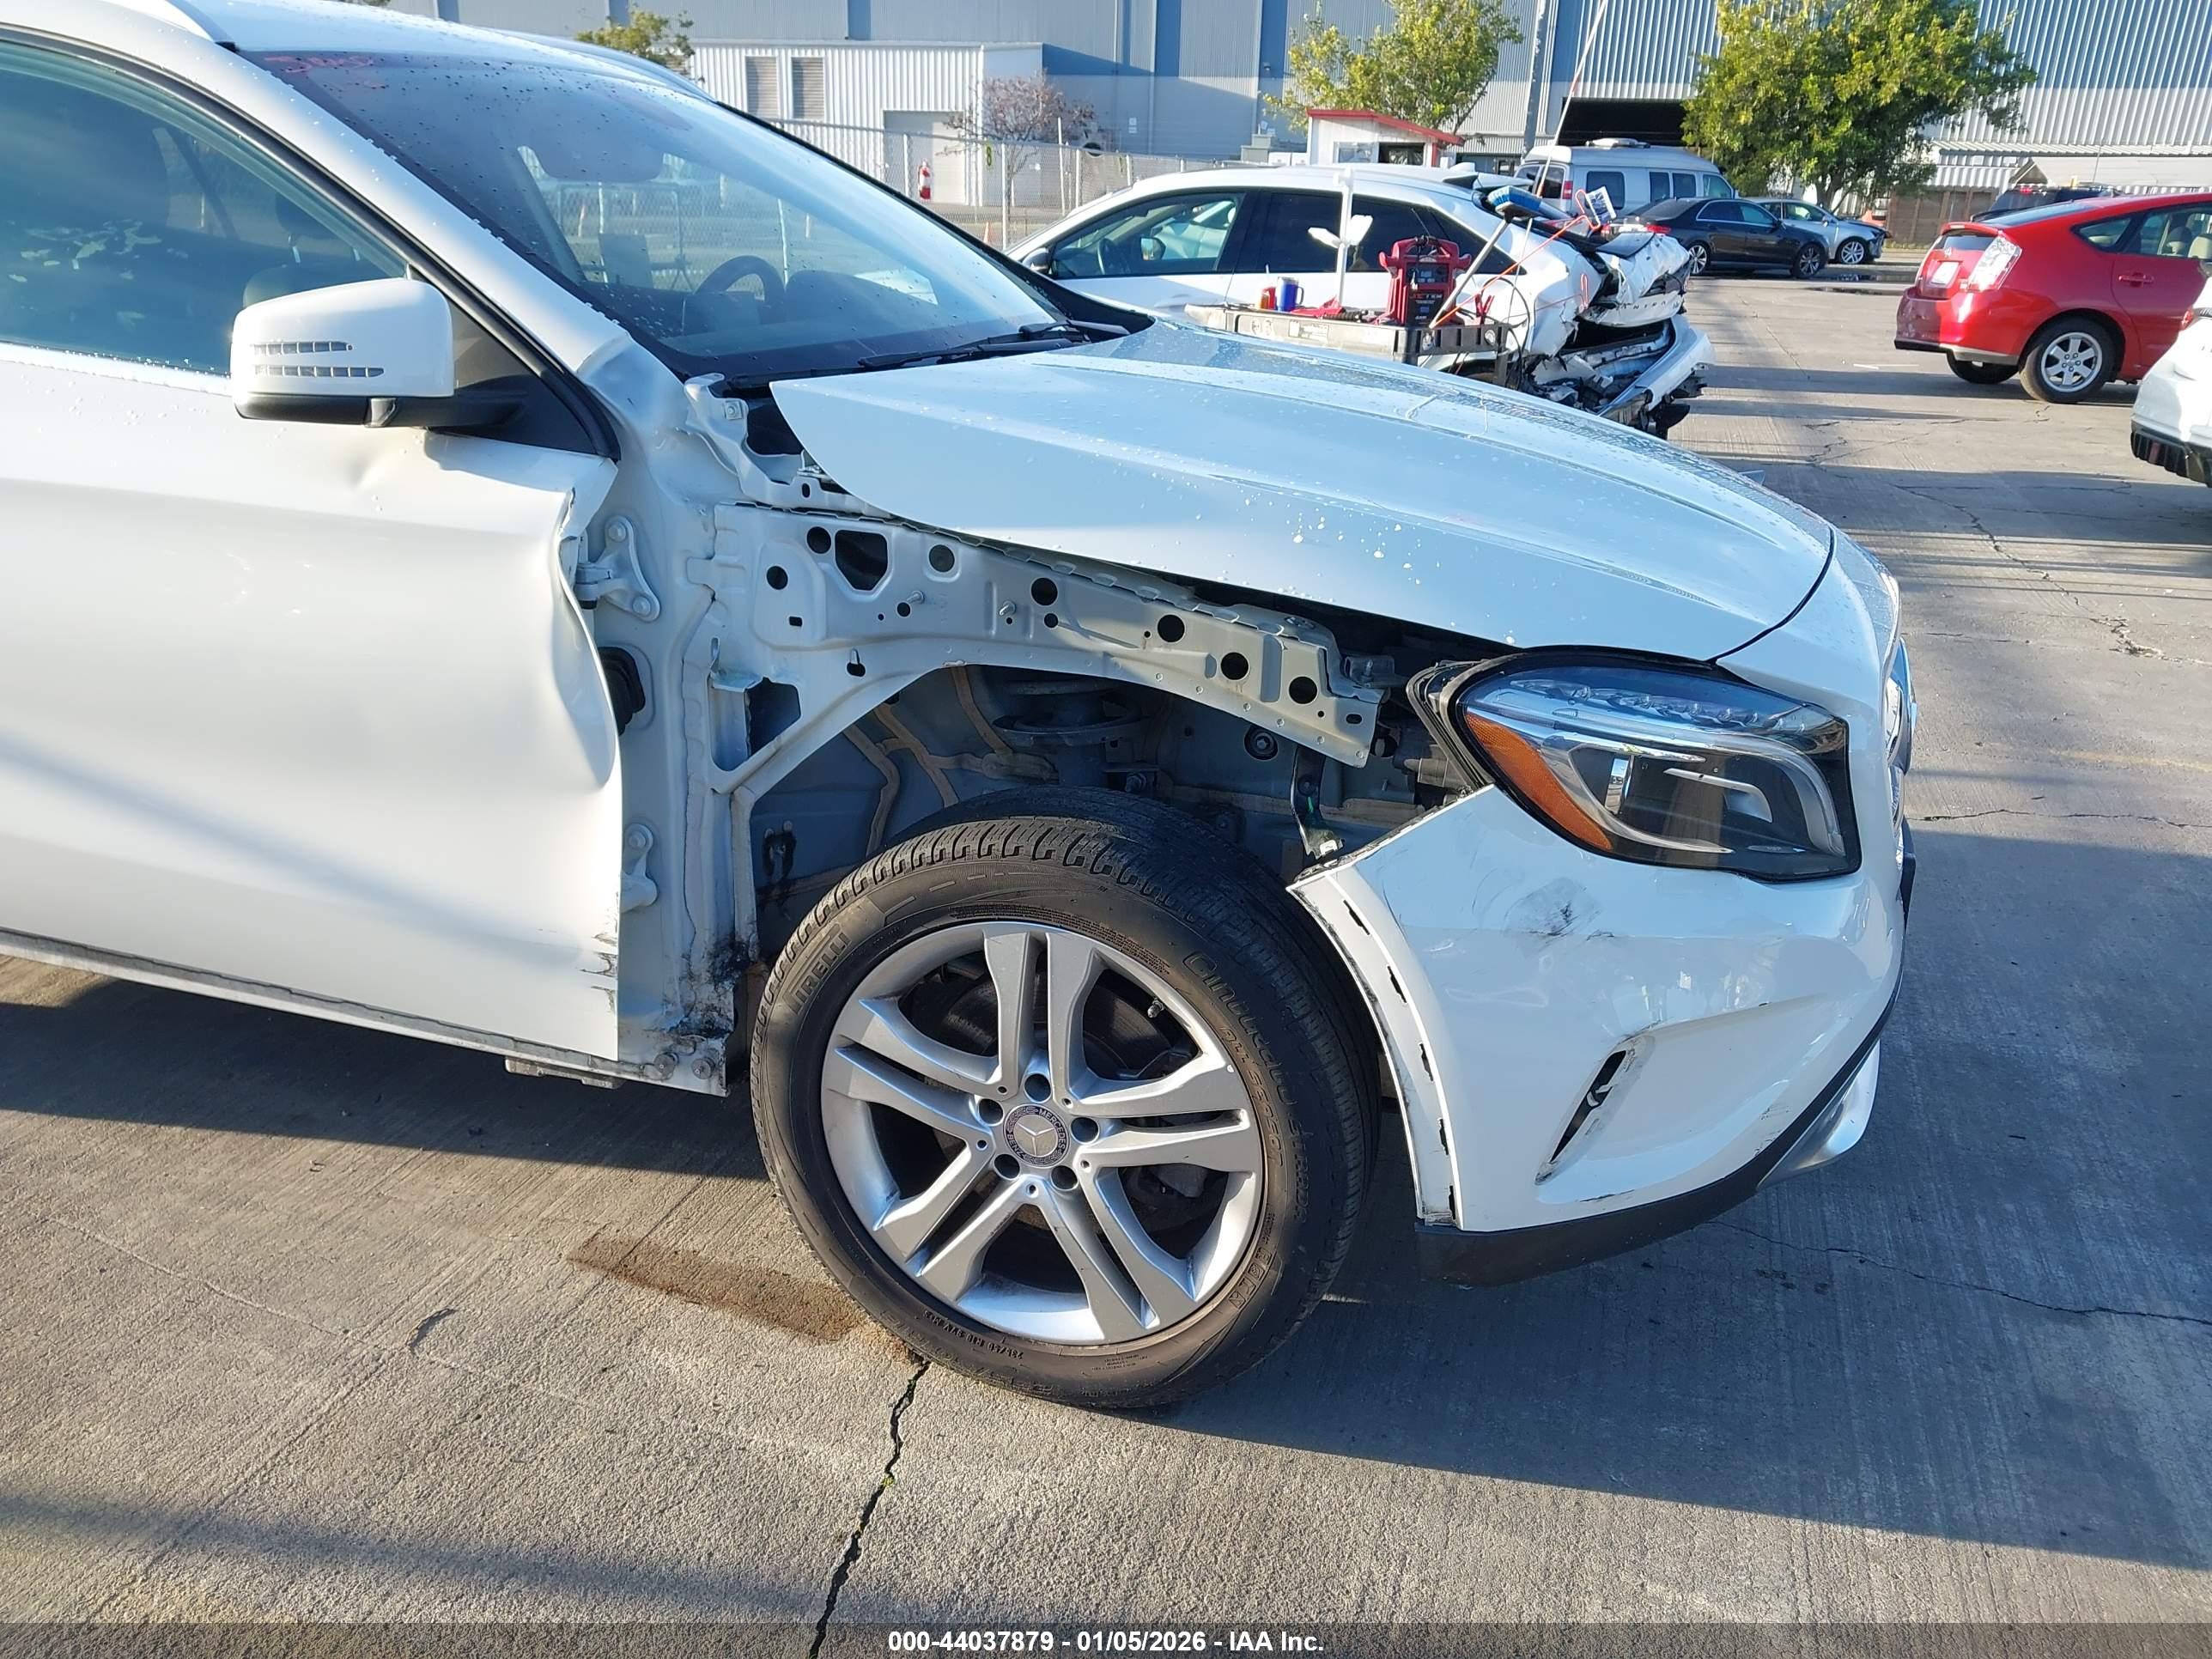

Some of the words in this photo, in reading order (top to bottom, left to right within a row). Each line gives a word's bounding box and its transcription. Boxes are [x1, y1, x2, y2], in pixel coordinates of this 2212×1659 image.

[782, 923, 852, 1015] PIRELLI
[1007, 1133, 1025, 1159] BENZ
[1039, 1109, 1066, 1152] MERCEDES
